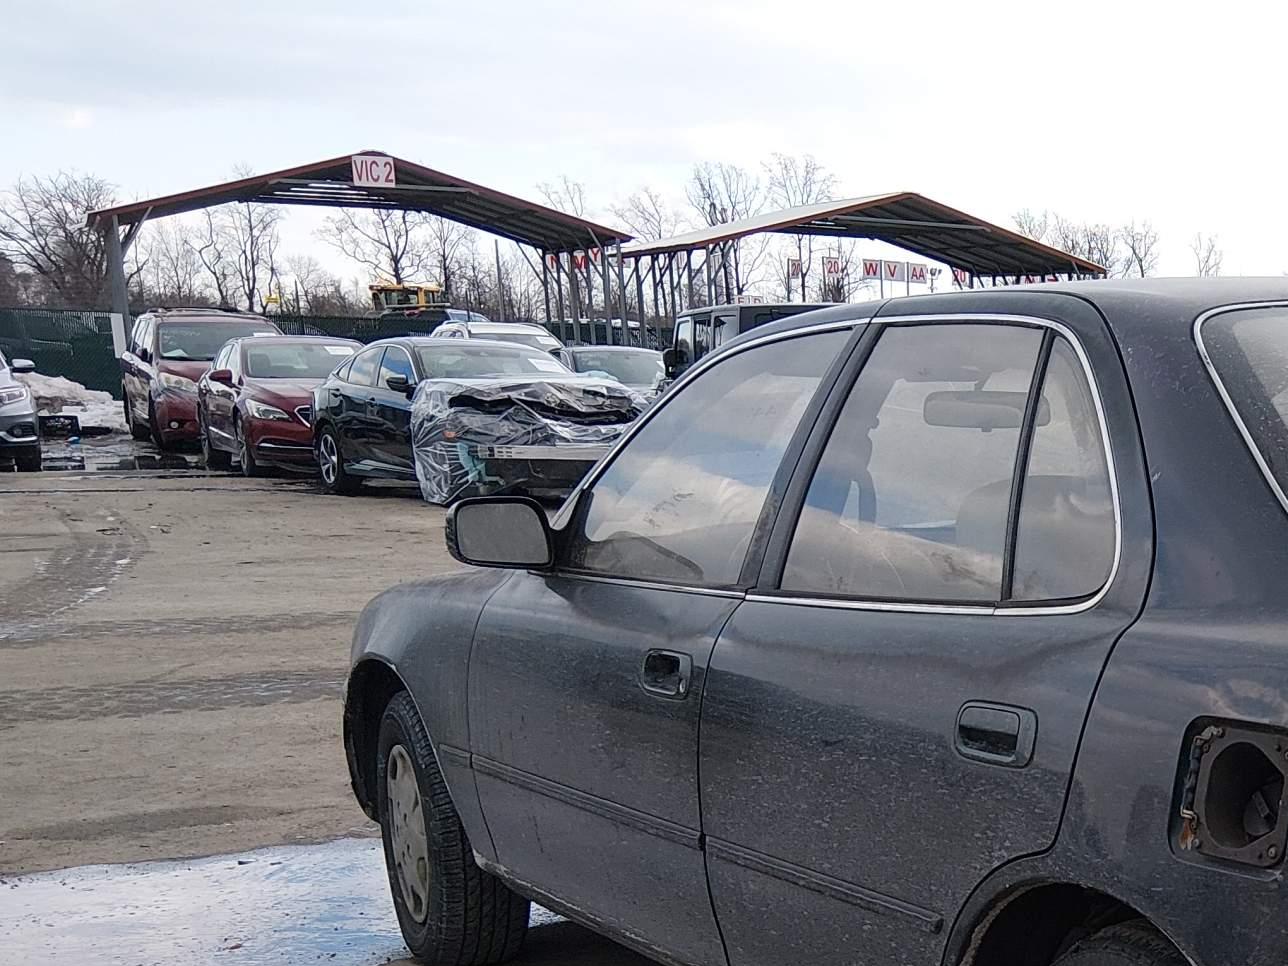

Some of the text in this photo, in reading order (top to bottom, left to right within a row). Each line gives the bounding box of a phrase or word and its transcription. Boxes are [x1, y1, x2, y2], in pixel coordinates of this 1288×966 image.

[353, 159, 394, 183] VIC 2
[827, 261, 839, 274] 20
[863, 262, 878, 276] W
[887, 264, 897, 277] V
[911, 266, 925, 281] AA
